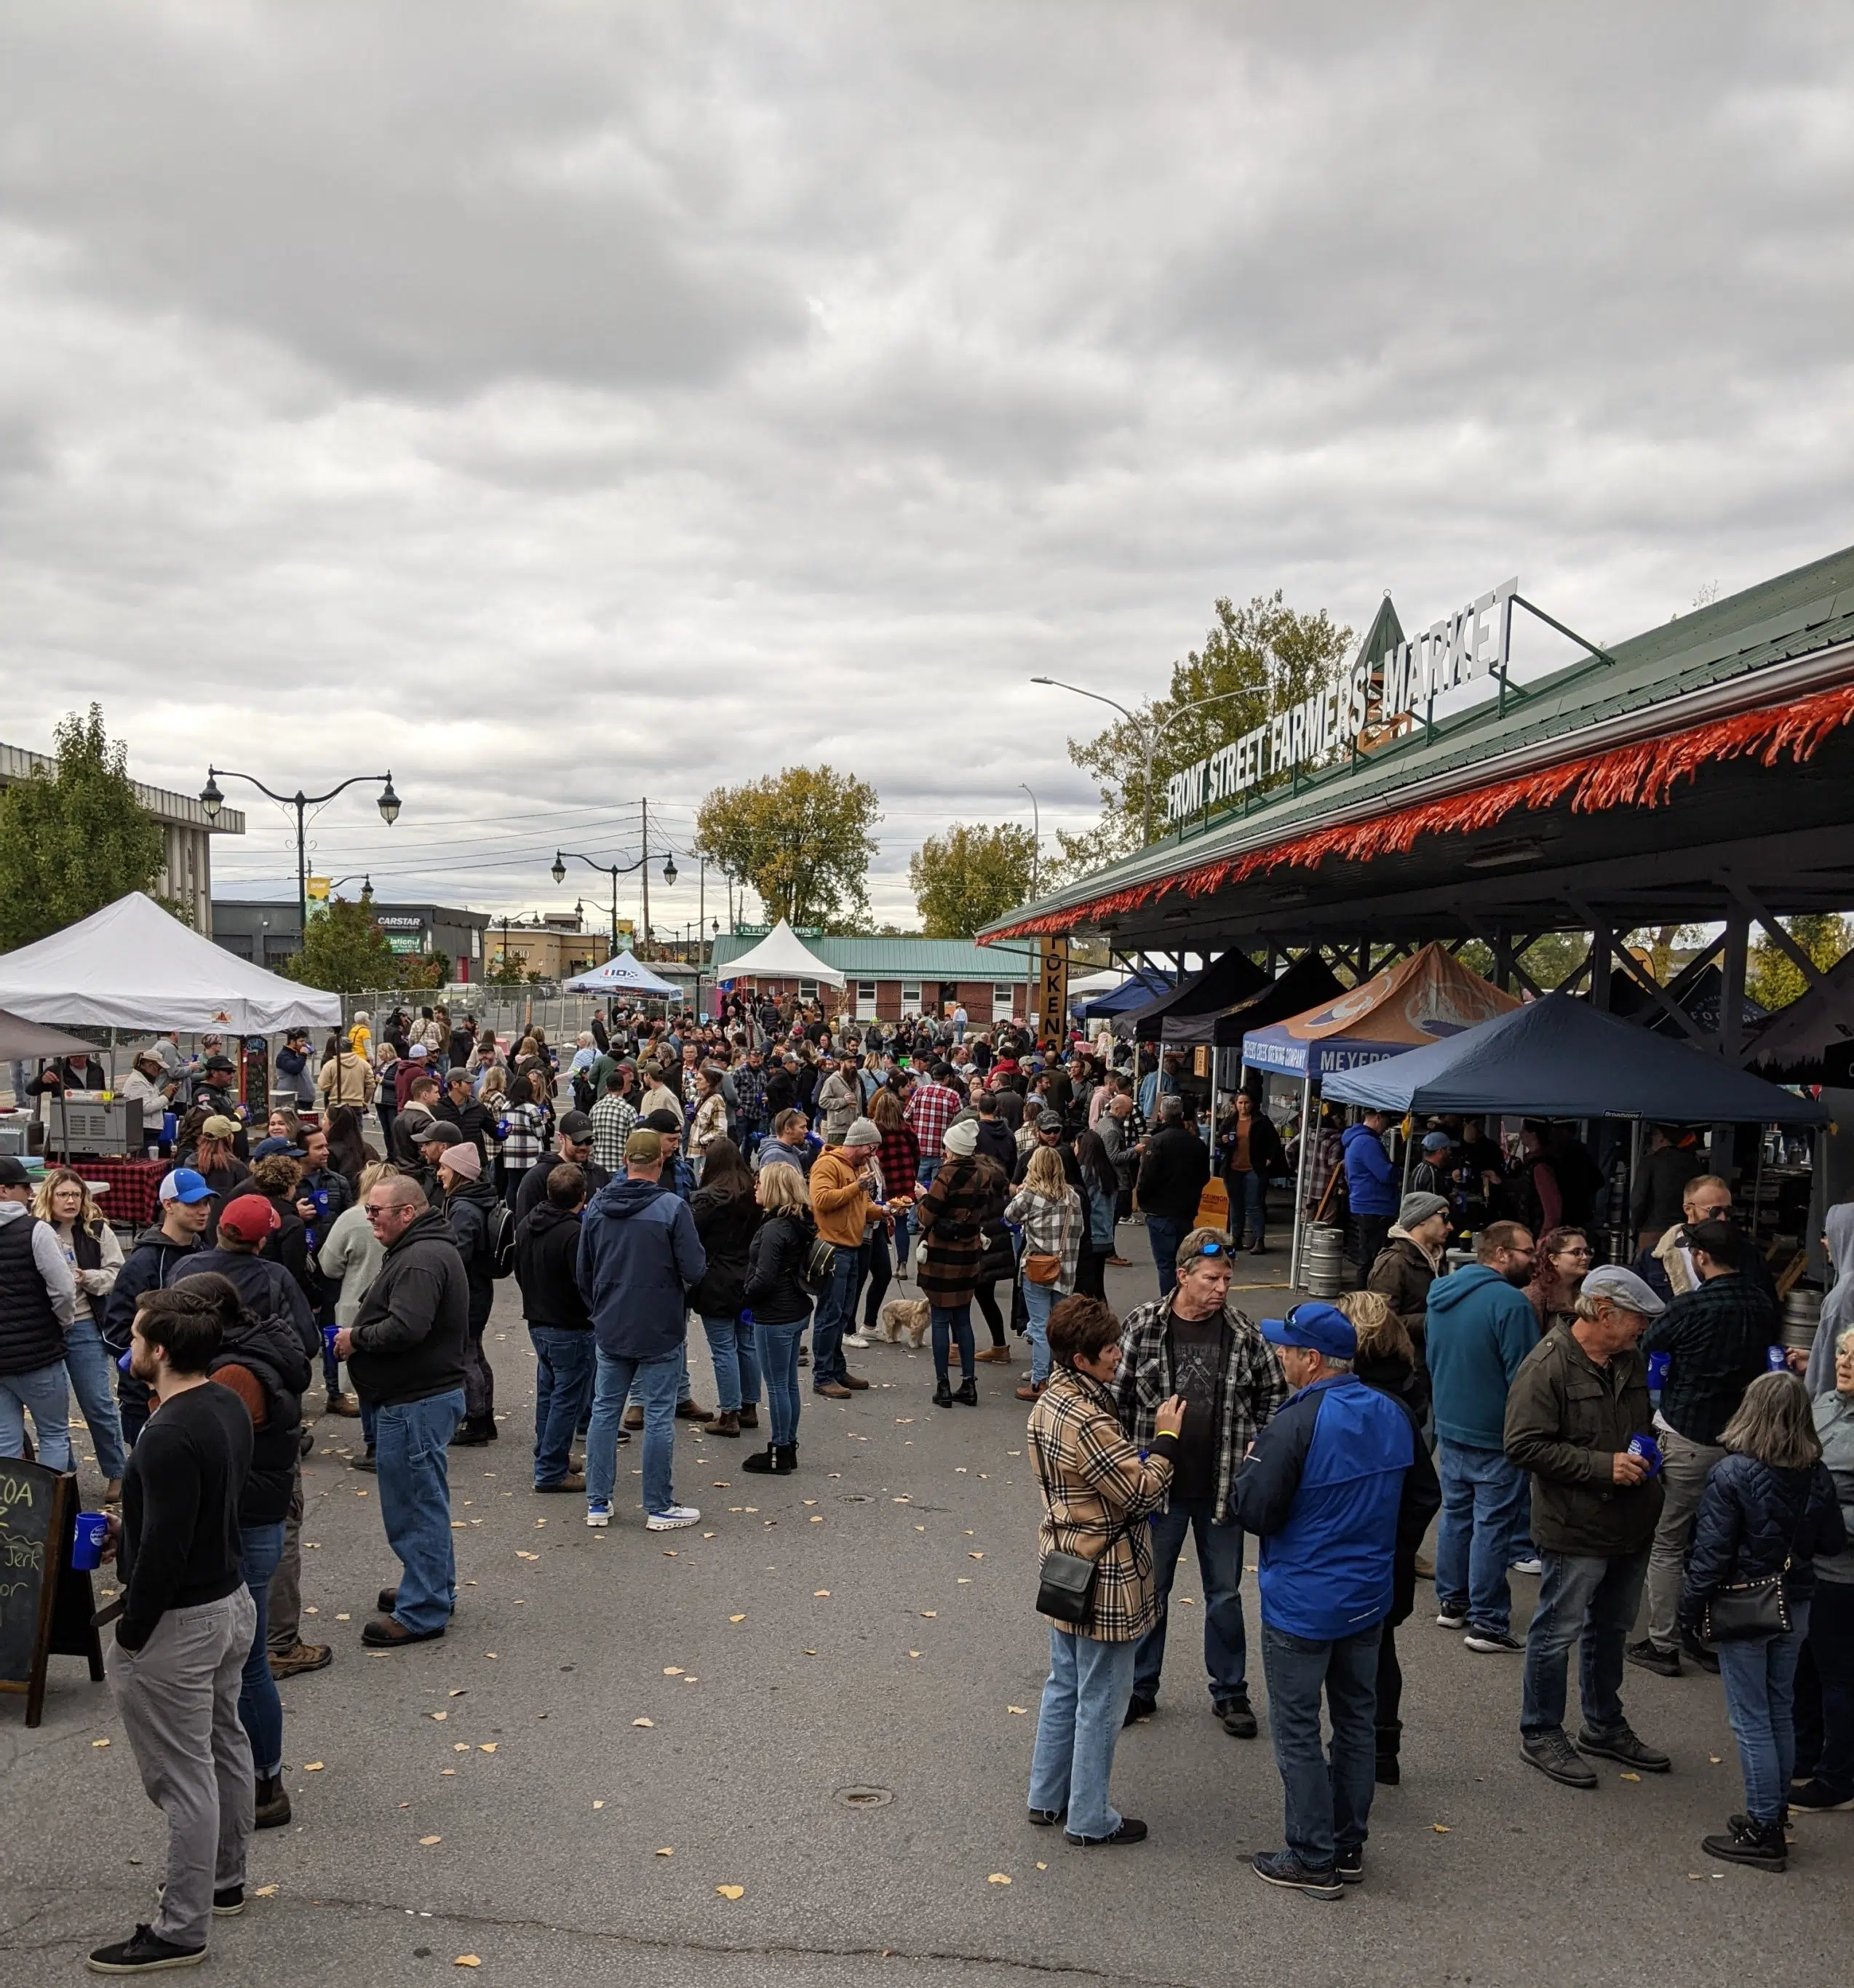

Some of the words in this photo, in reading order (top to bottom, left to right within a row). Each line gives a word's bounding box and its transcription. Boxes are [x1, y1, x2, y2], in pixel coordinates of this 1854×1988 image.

[1168, 759, 1207, 821] FRONT
[1208, 723, 1268, 804] STREET
[1382, 576, 1518, 722] MARKET
[378, 917, 421, 926] CARSTAR
[740, 926, 812, 934] INFORTION
[0, 1475, 33, 1508] OA
[4, 1545, 41, 1572] Jerk
